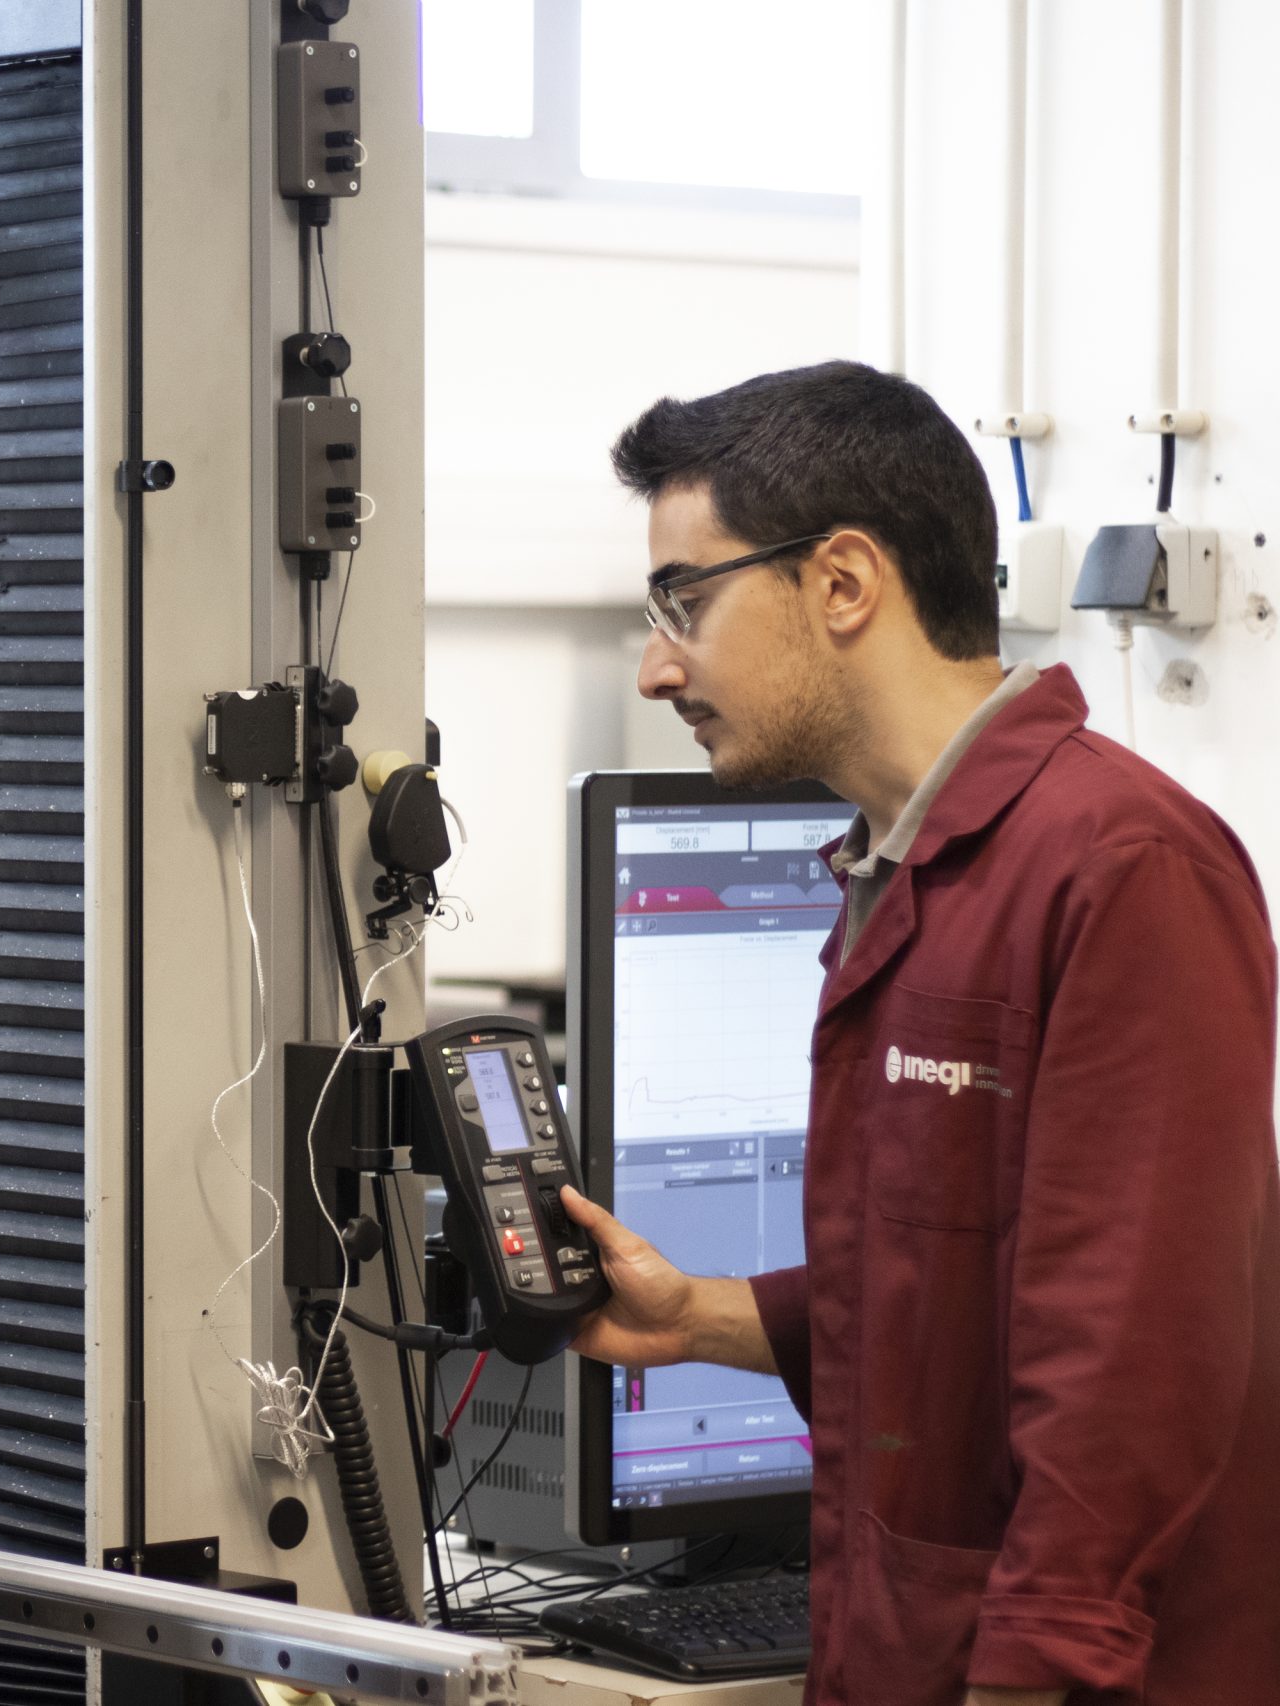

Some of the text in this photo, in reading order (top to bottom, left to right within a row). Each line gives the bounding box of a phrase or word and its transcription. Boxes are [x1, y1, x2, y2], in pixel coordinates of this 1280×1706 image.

[655, 825, 695, 834] Displacement
[802, 823, 817, 832] Force
[670, 837, 699, 849] 569.8
[751, 890, 773, 899] Method
[904, 1055, 970, 1096] inegi
[646, 1461, 688, 1473] displacement
